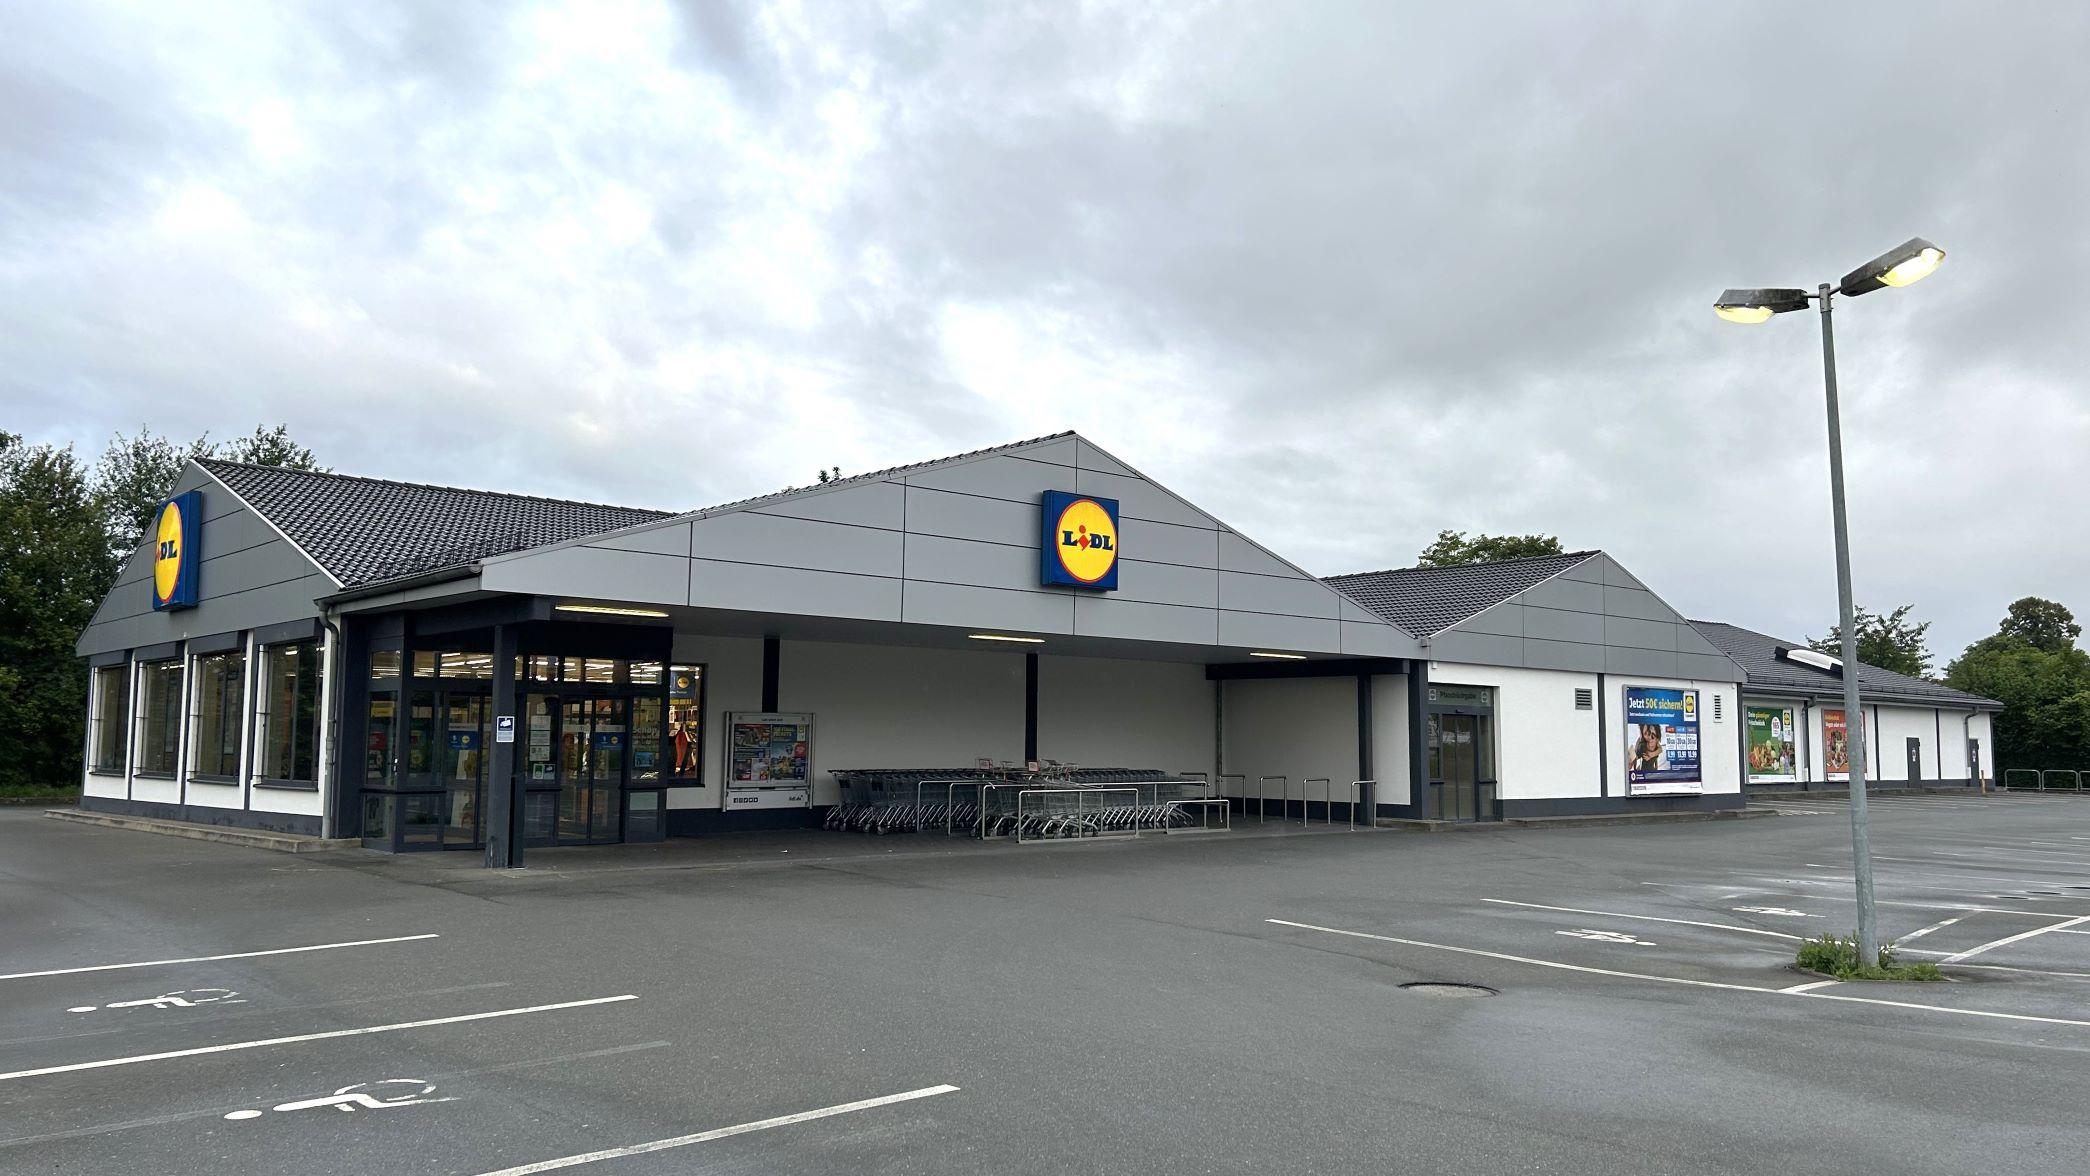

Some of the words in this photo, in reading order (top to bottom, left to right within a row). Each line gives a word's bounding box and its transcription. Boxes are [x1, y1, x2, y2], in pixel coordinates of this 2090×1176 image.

[1629, 697, 1644, 709] Jetzt
[1645, 698, 1658, 709] 50€
[1659, 698, 1683, 710] sichern!
